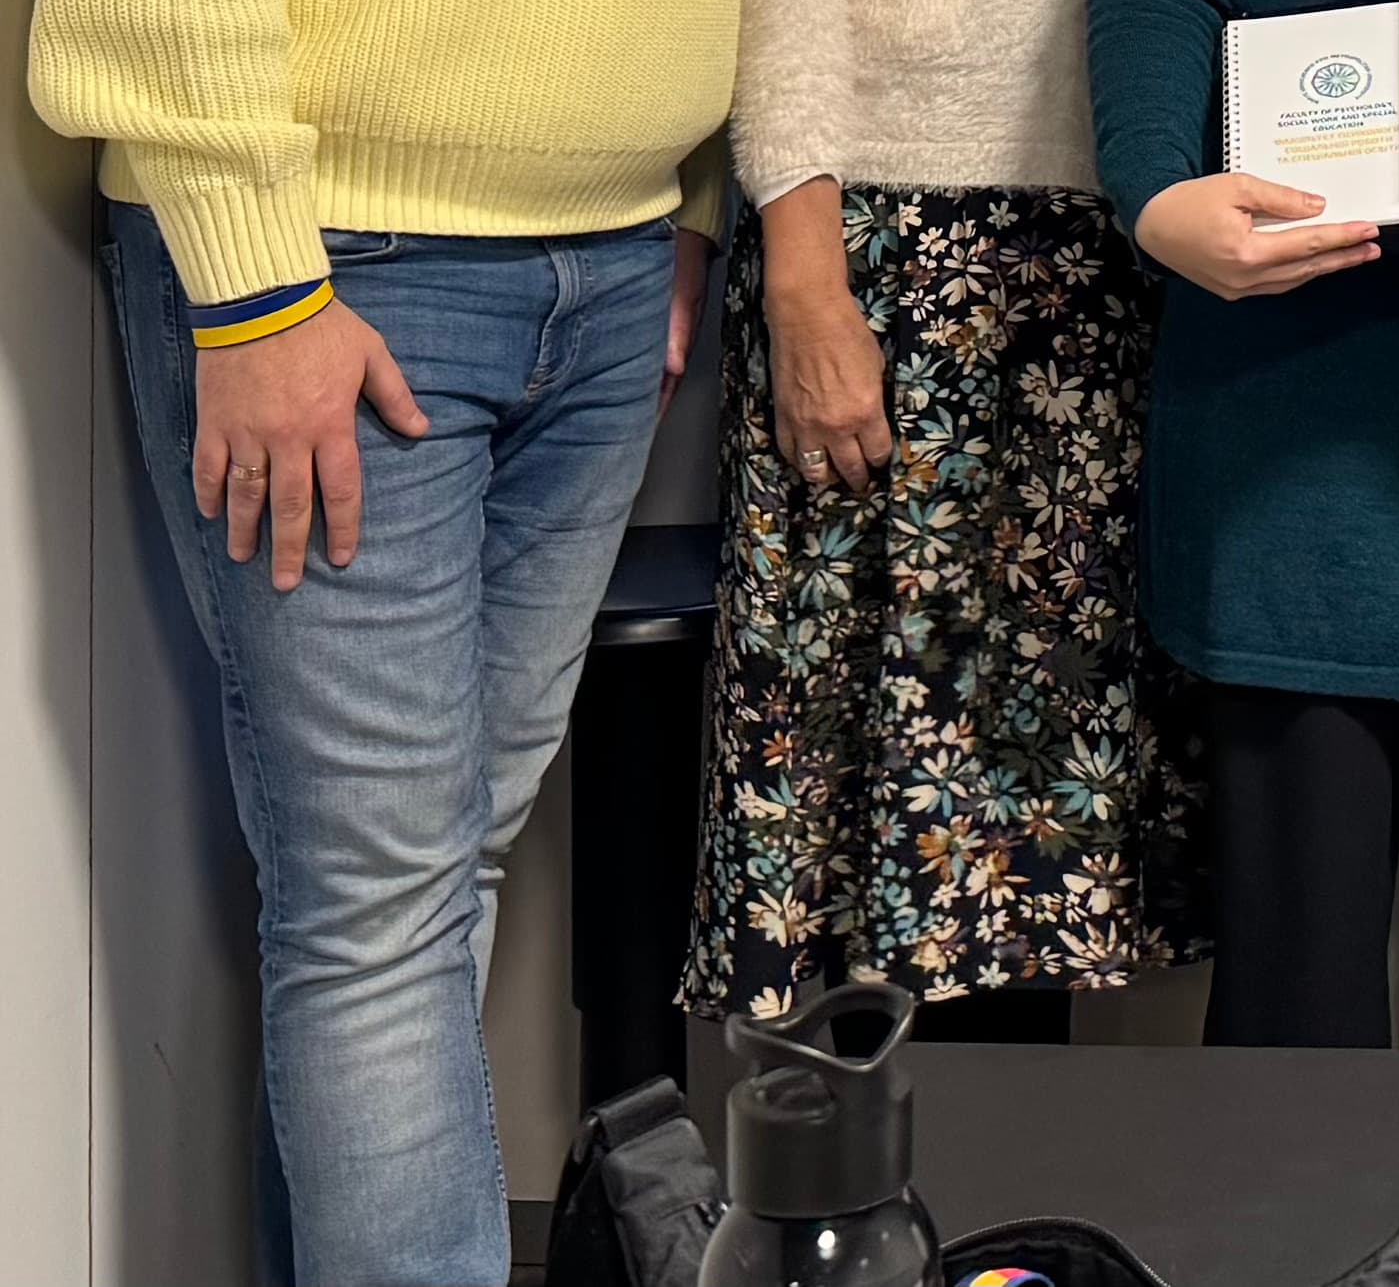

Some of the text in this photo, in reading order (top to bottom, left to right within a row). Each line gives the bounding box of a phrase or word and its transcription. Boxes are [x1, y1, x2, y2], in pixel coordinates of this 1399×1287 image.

[1280, 109, 1318, 119] FACULTY
[1320, 107, 1333, 115] OF
[1278, 118, 1308, 128] SOCIAL
[1311, 115, 1338, 124] WORK
[1341, 113, 1360, 121] AND
[1312, 121, 1364, 132] EDUCATION
